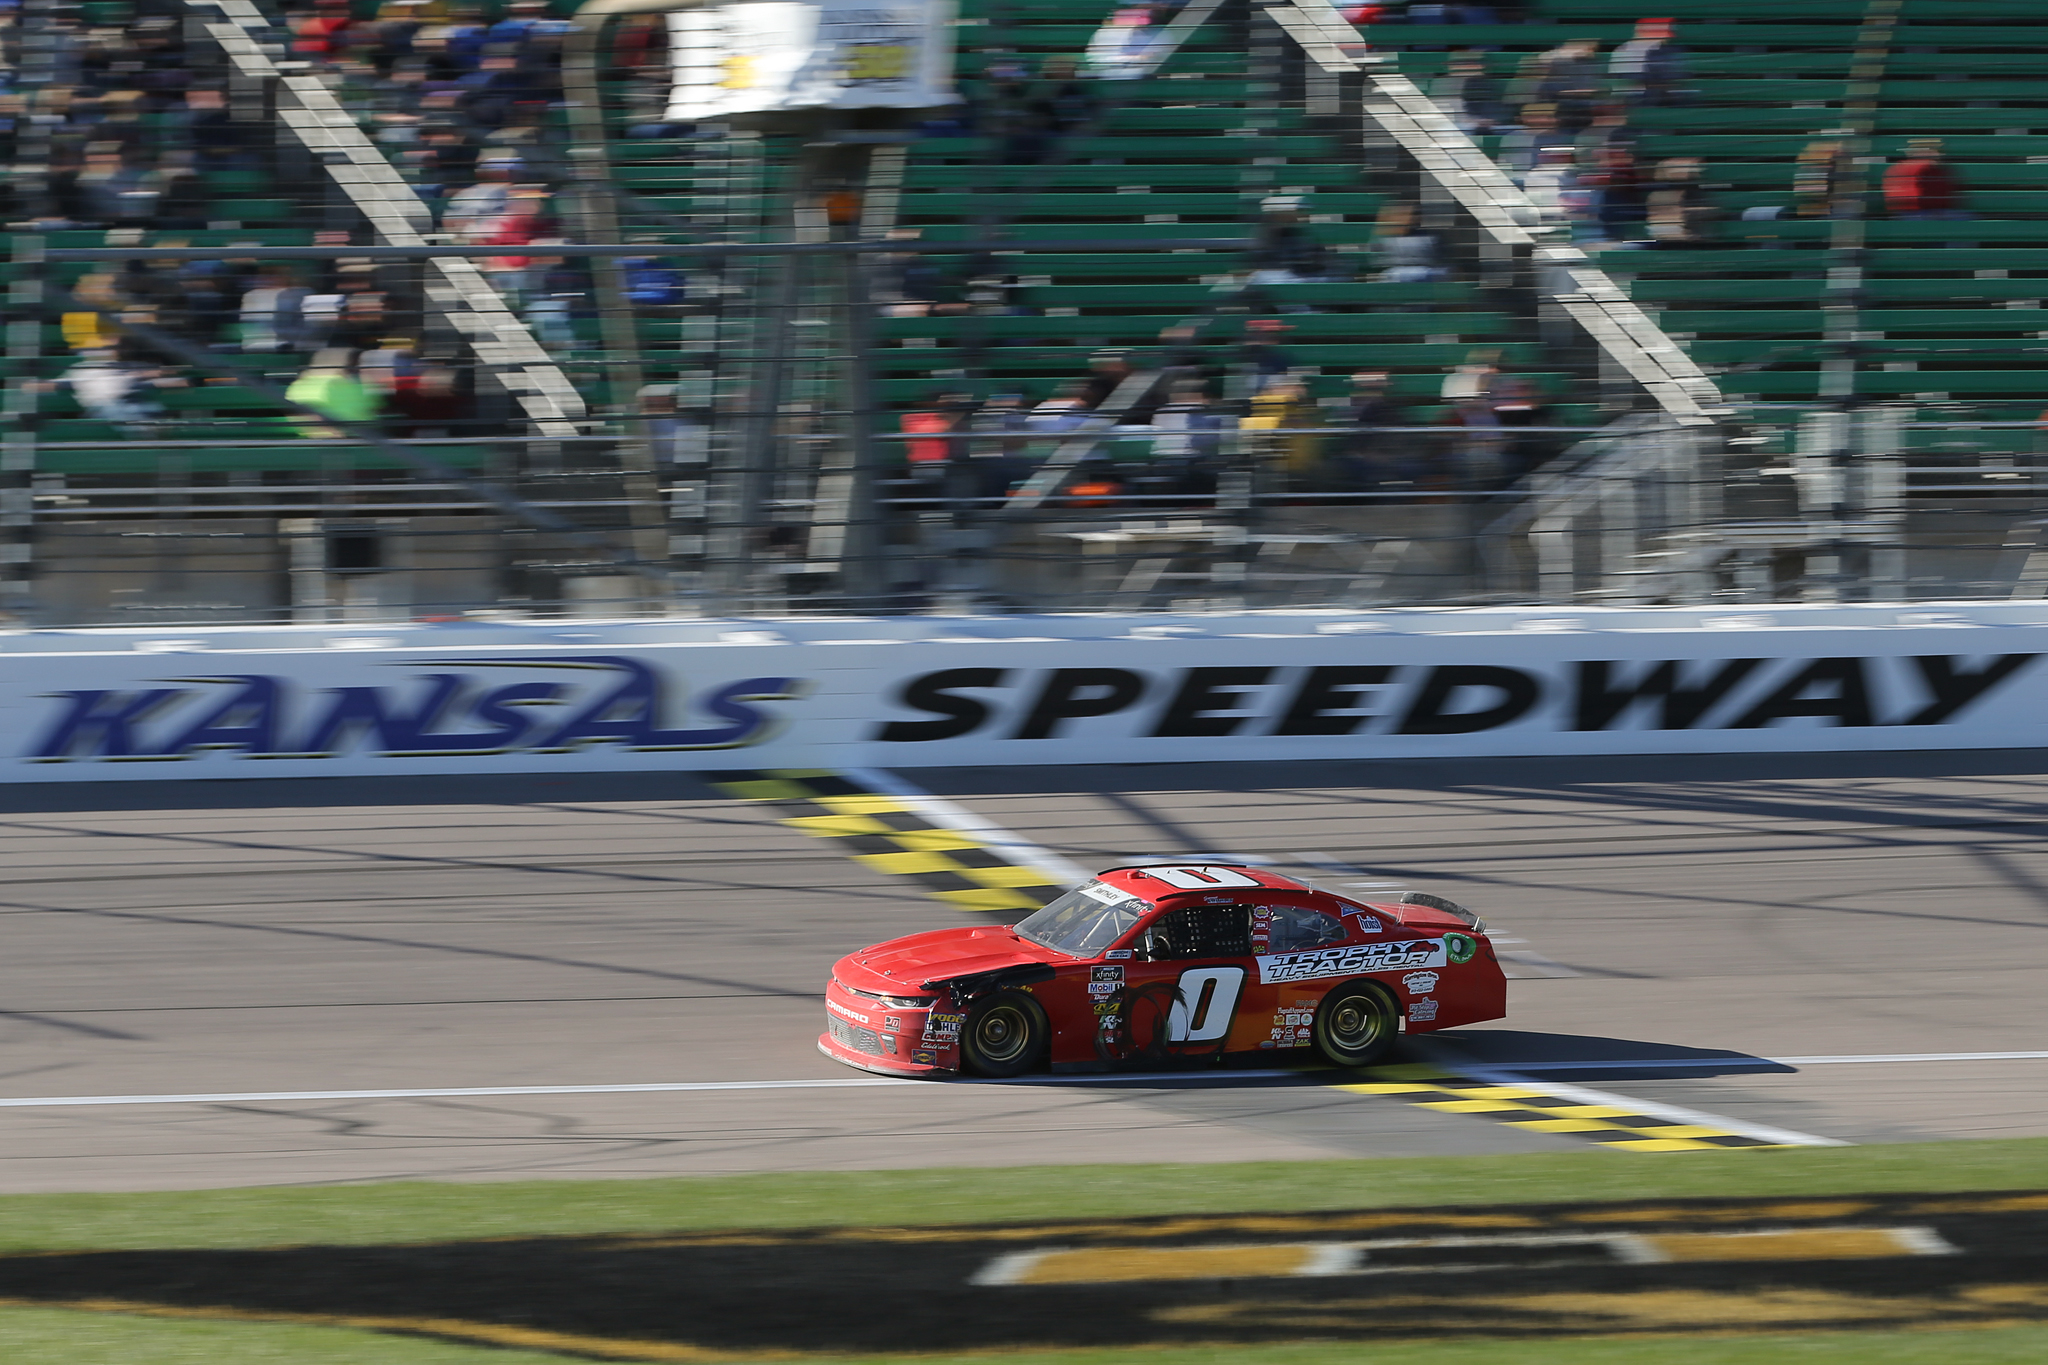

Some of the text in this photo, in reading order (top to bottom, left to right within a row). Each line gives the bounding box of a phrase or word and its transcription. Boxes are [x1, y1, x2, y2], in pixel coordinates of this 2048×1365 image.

[20, 653, 2042, 760] KANSAS SPEEDWAY
[1093, 888, 1120, 900] SMITHLEY
[1268, 951, 1430, 979] TRACTOR
[1273, 941, 1416, 965] TROPHY
[1096, 970, 1119, 979] xfinity
[1302, 970, 1355, 979] EQUIPMENT
[1090, 983, 1113, 991] Mobil
[827, 998, 869, 1024] CAMARO
[1166, 966, 1244, 1042] 0
